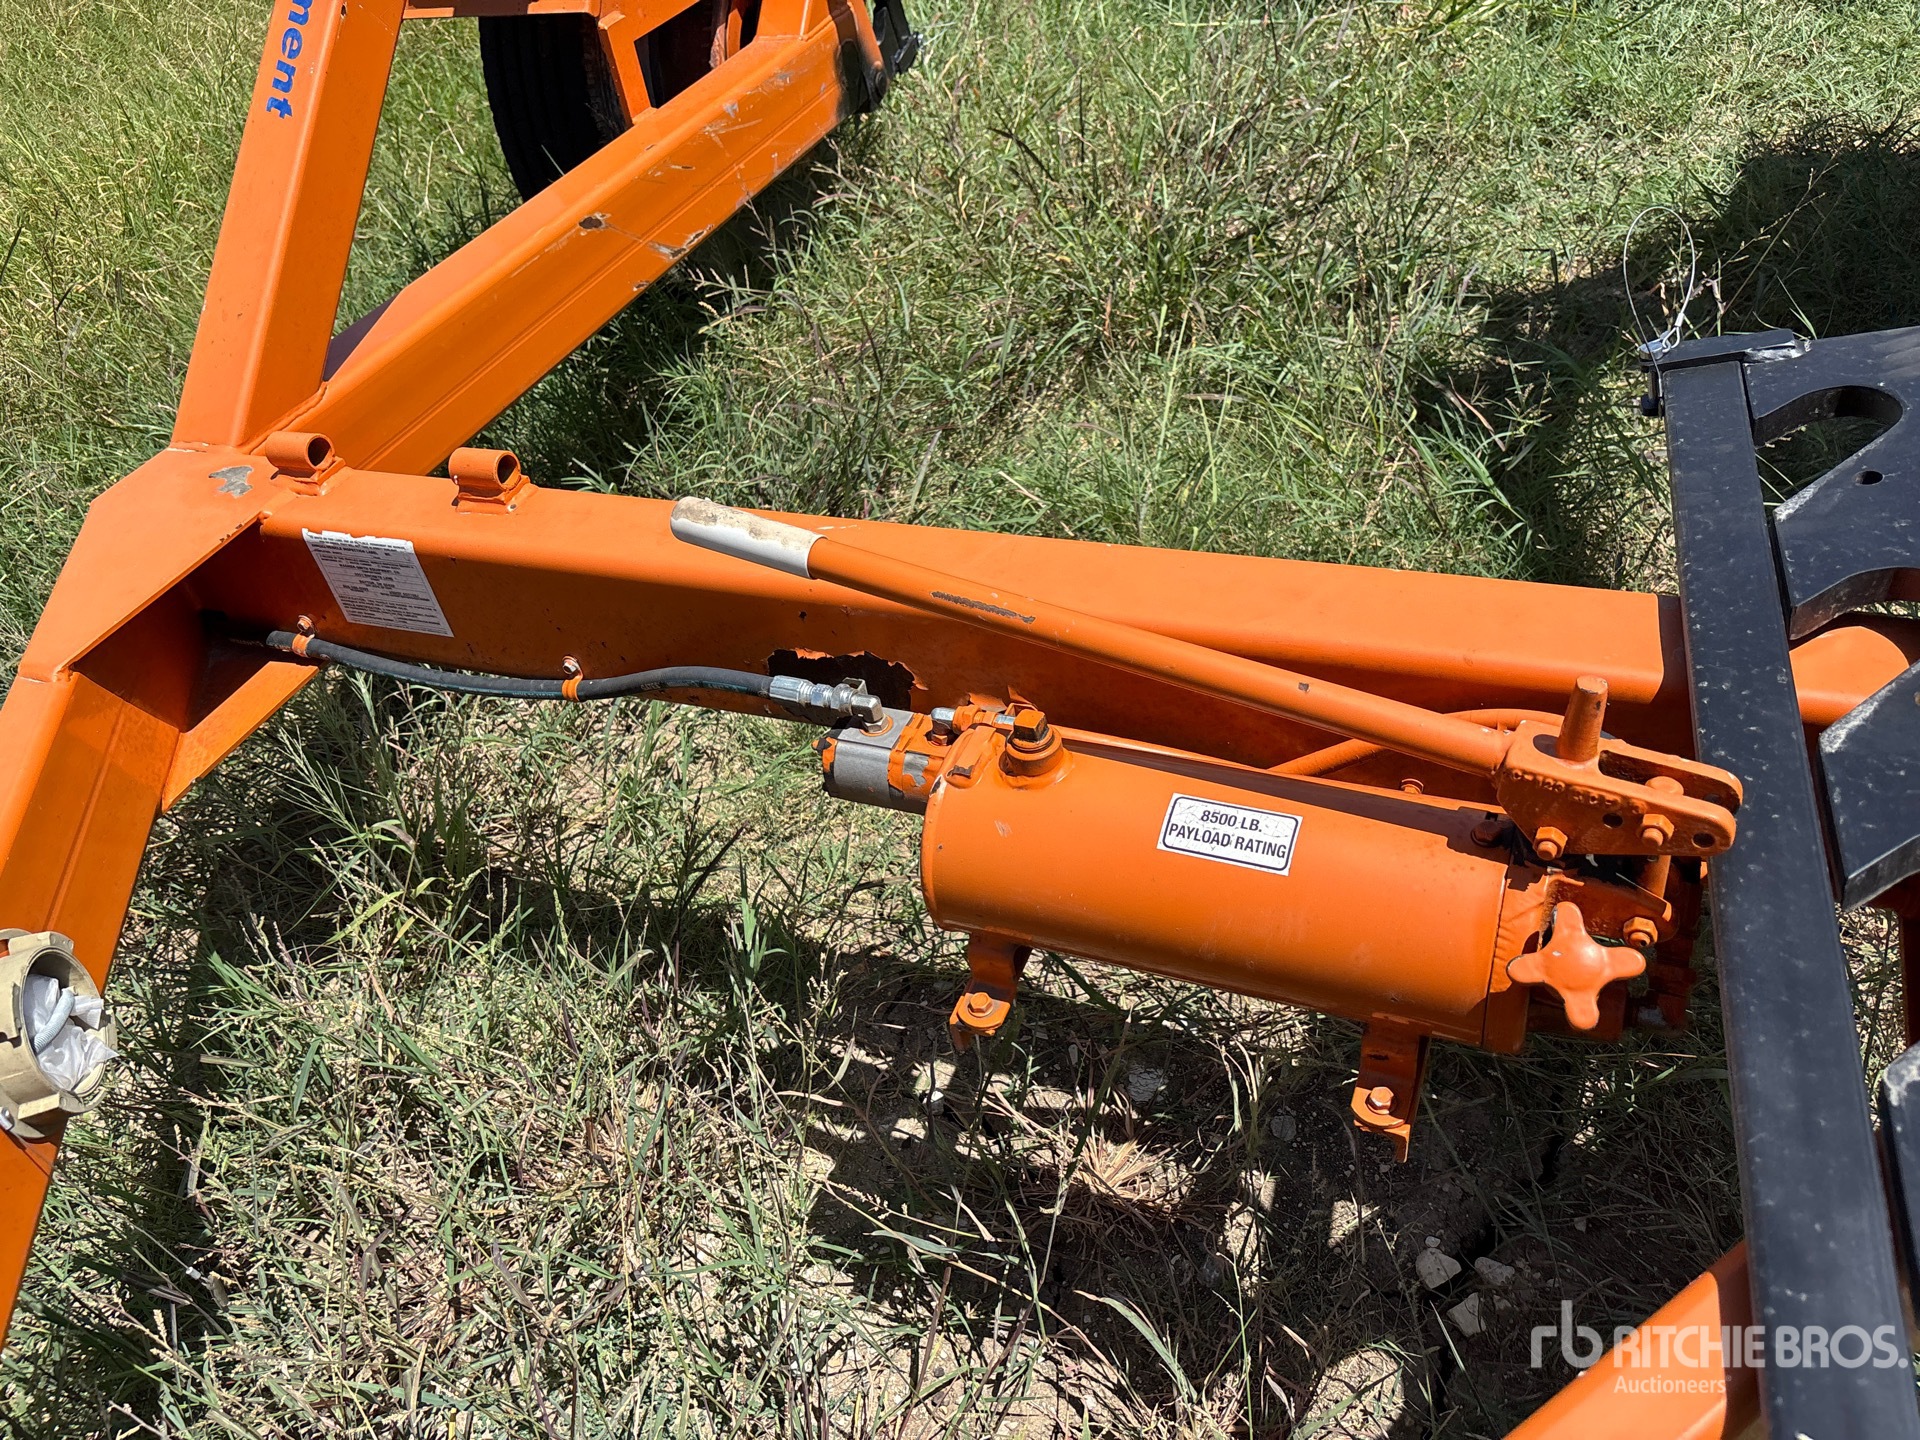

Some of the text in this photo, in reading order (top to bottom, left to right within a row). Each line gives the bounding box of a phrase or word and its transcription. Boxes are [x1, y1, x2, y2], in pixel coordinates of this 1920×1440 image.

[1200, 809, 1262, 833] 8500 LB.
[1168, 823, 1287, 858] PAYLOAD RATING
